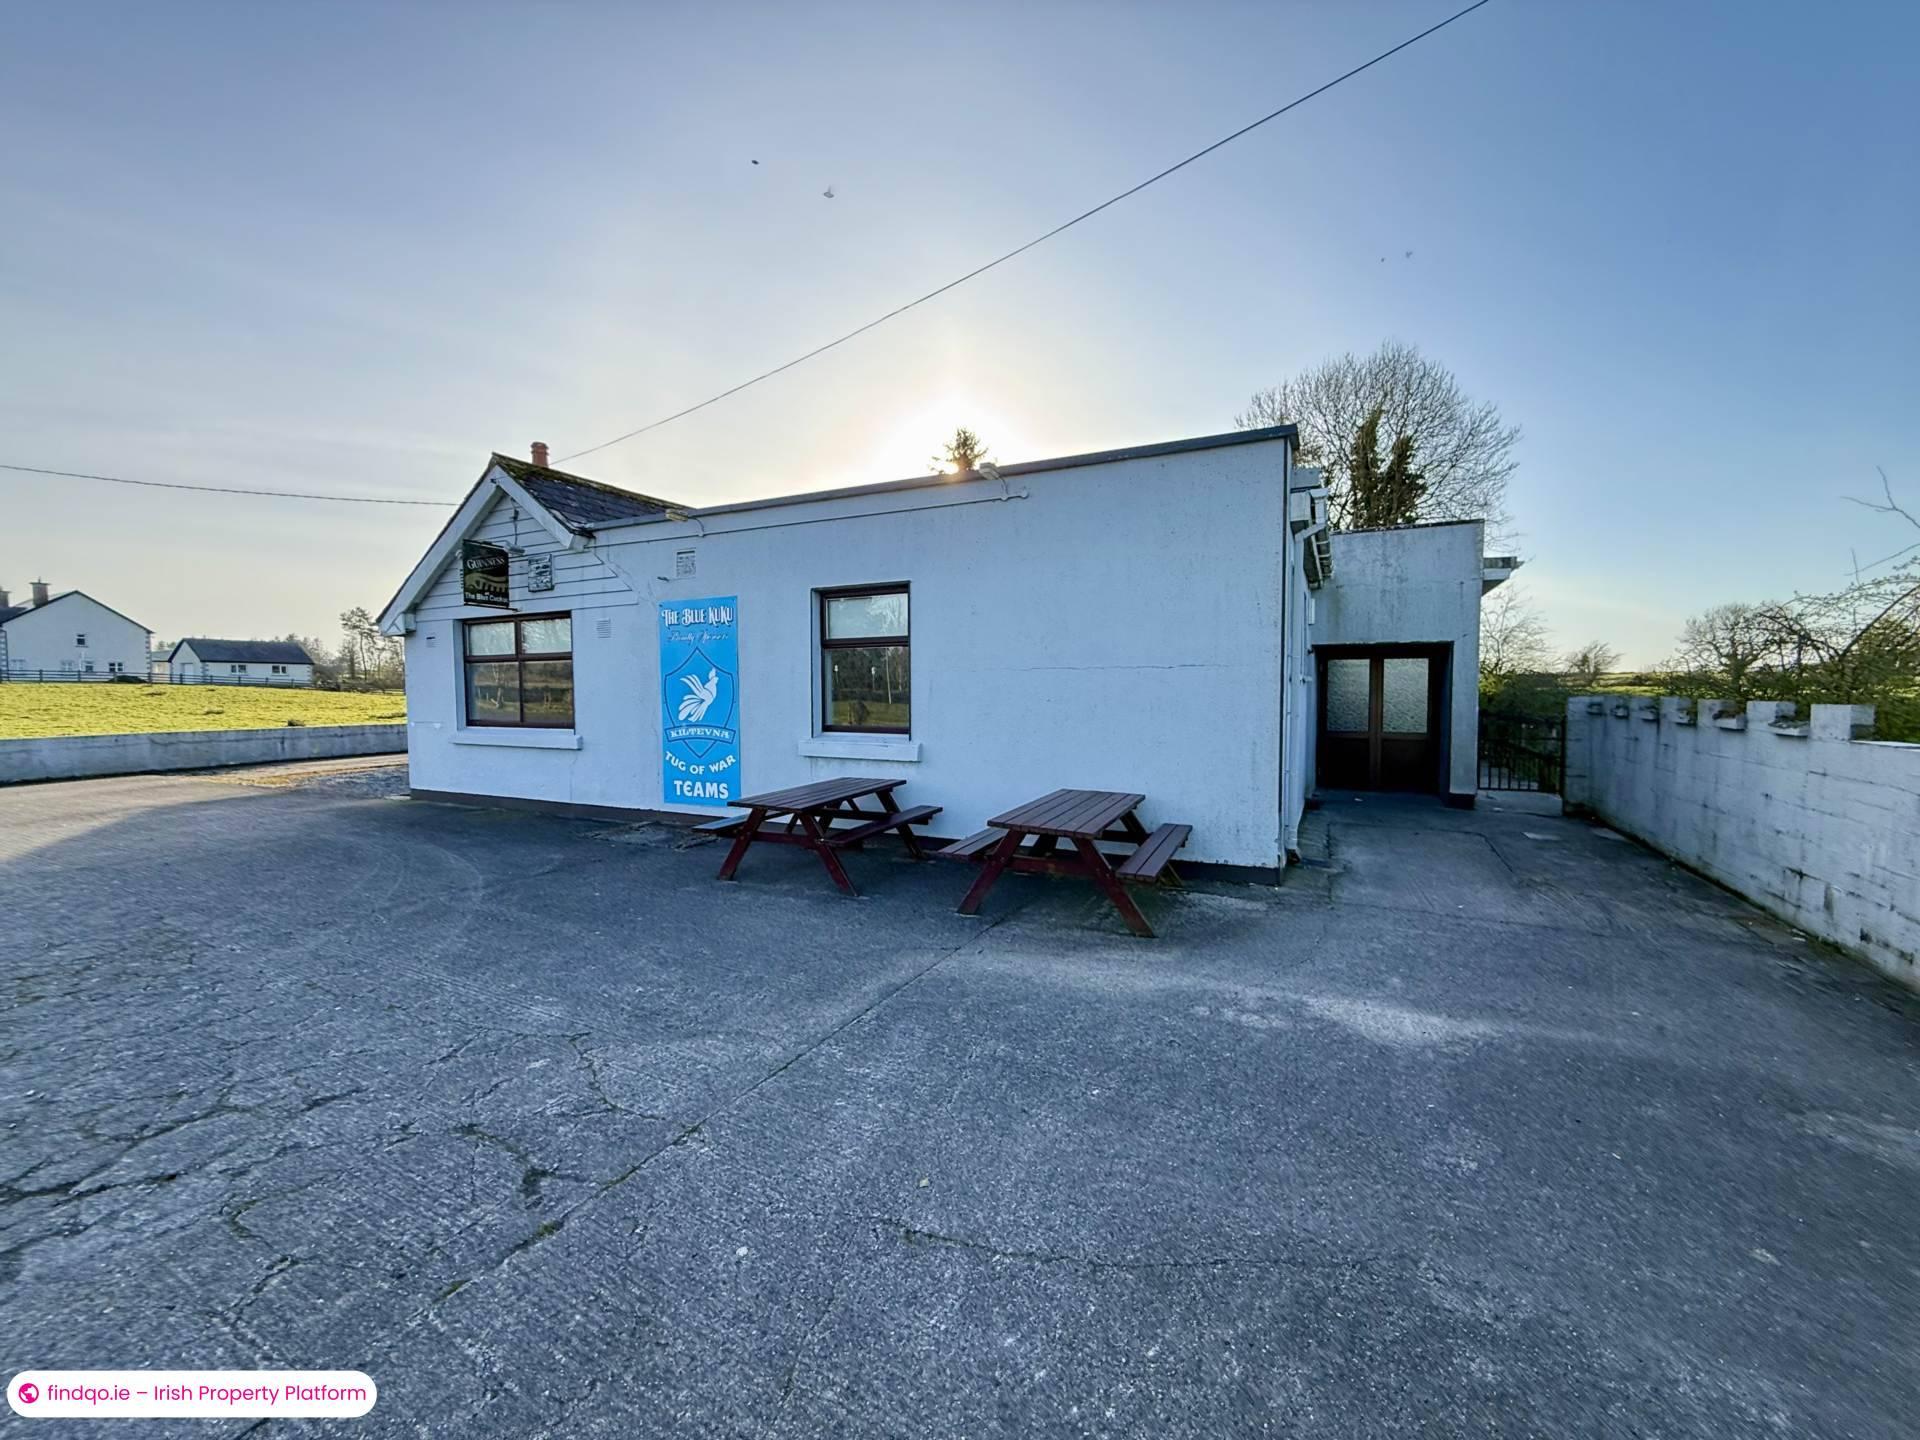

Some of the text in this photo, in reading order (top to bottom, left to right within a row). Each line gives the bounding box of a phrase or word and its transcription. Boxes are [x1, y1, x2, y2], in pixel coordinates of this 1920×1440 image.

[661, 606, 733, 627] THE BLUE KUKU
[670, 727, 730, 739] KILTEVNA
[665, 751, 737, 775] TUG OF WAR
[673, 780, 729, 800] TEAMS
